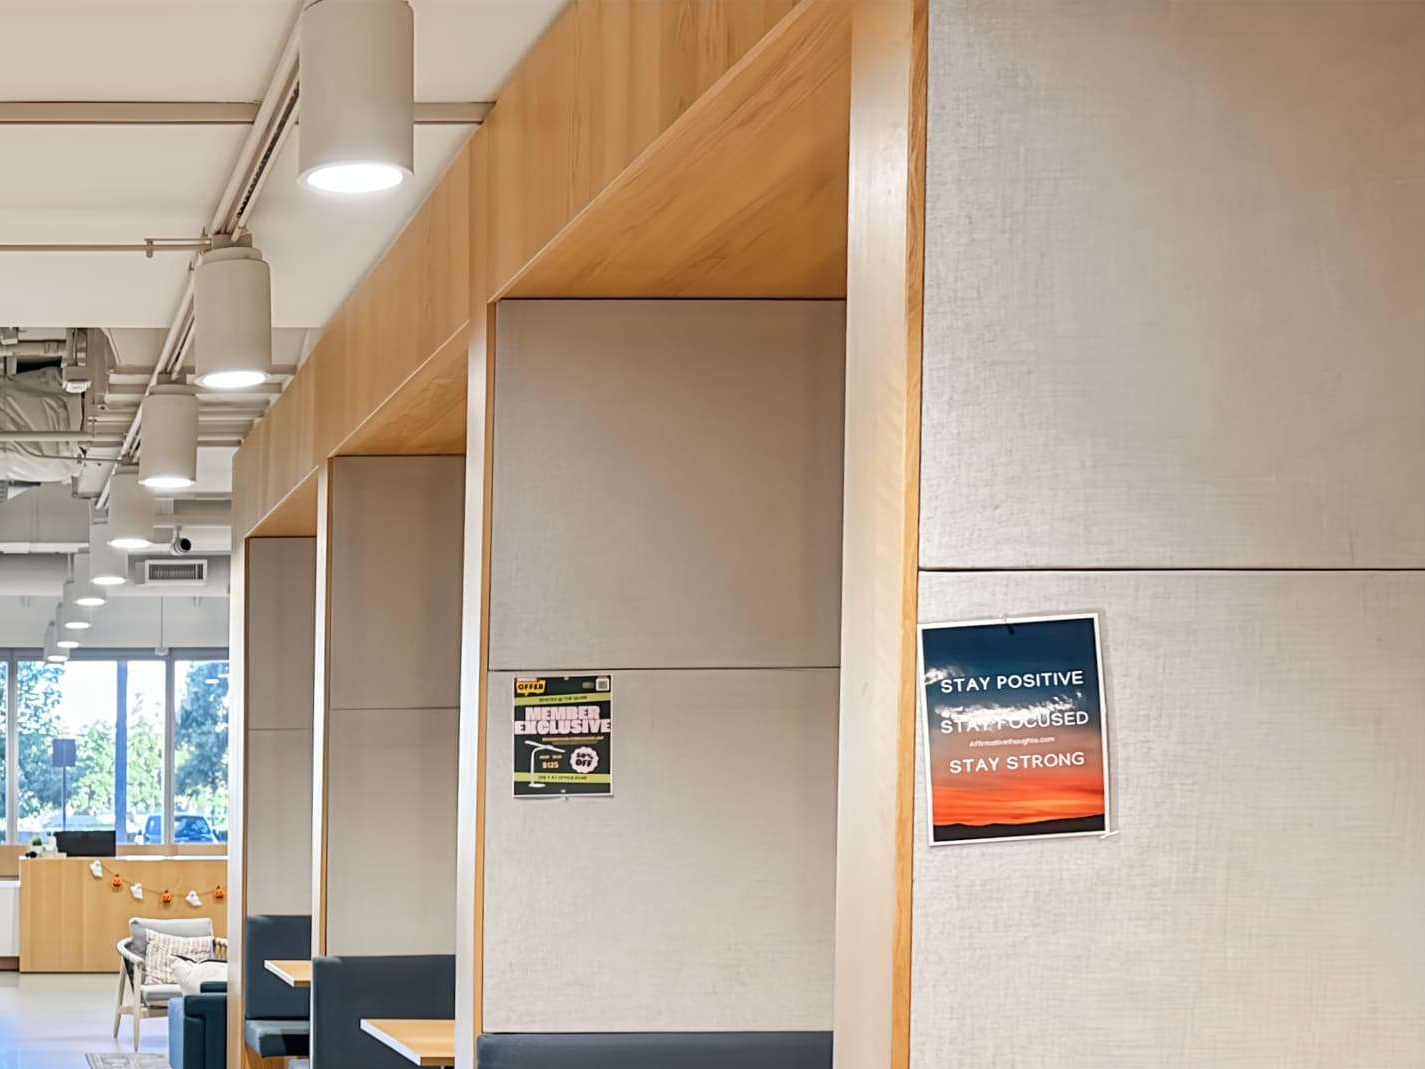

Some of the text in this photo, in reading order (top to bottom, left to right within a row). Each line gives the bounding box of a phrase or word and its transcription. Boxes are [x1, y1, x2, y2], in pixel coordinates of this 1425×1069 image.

[941, 671, 1084, 693] STAY POSITIVE
[525, 706, 600, 720] MEMBER
[941, 711, 1089, 733] STAY FOCUSED
[514, 719, 611, 734] EXCLUSIVE
[576, 759, 592, 767] OFF
[950, 752, 1085, 774] STAY STRONG
